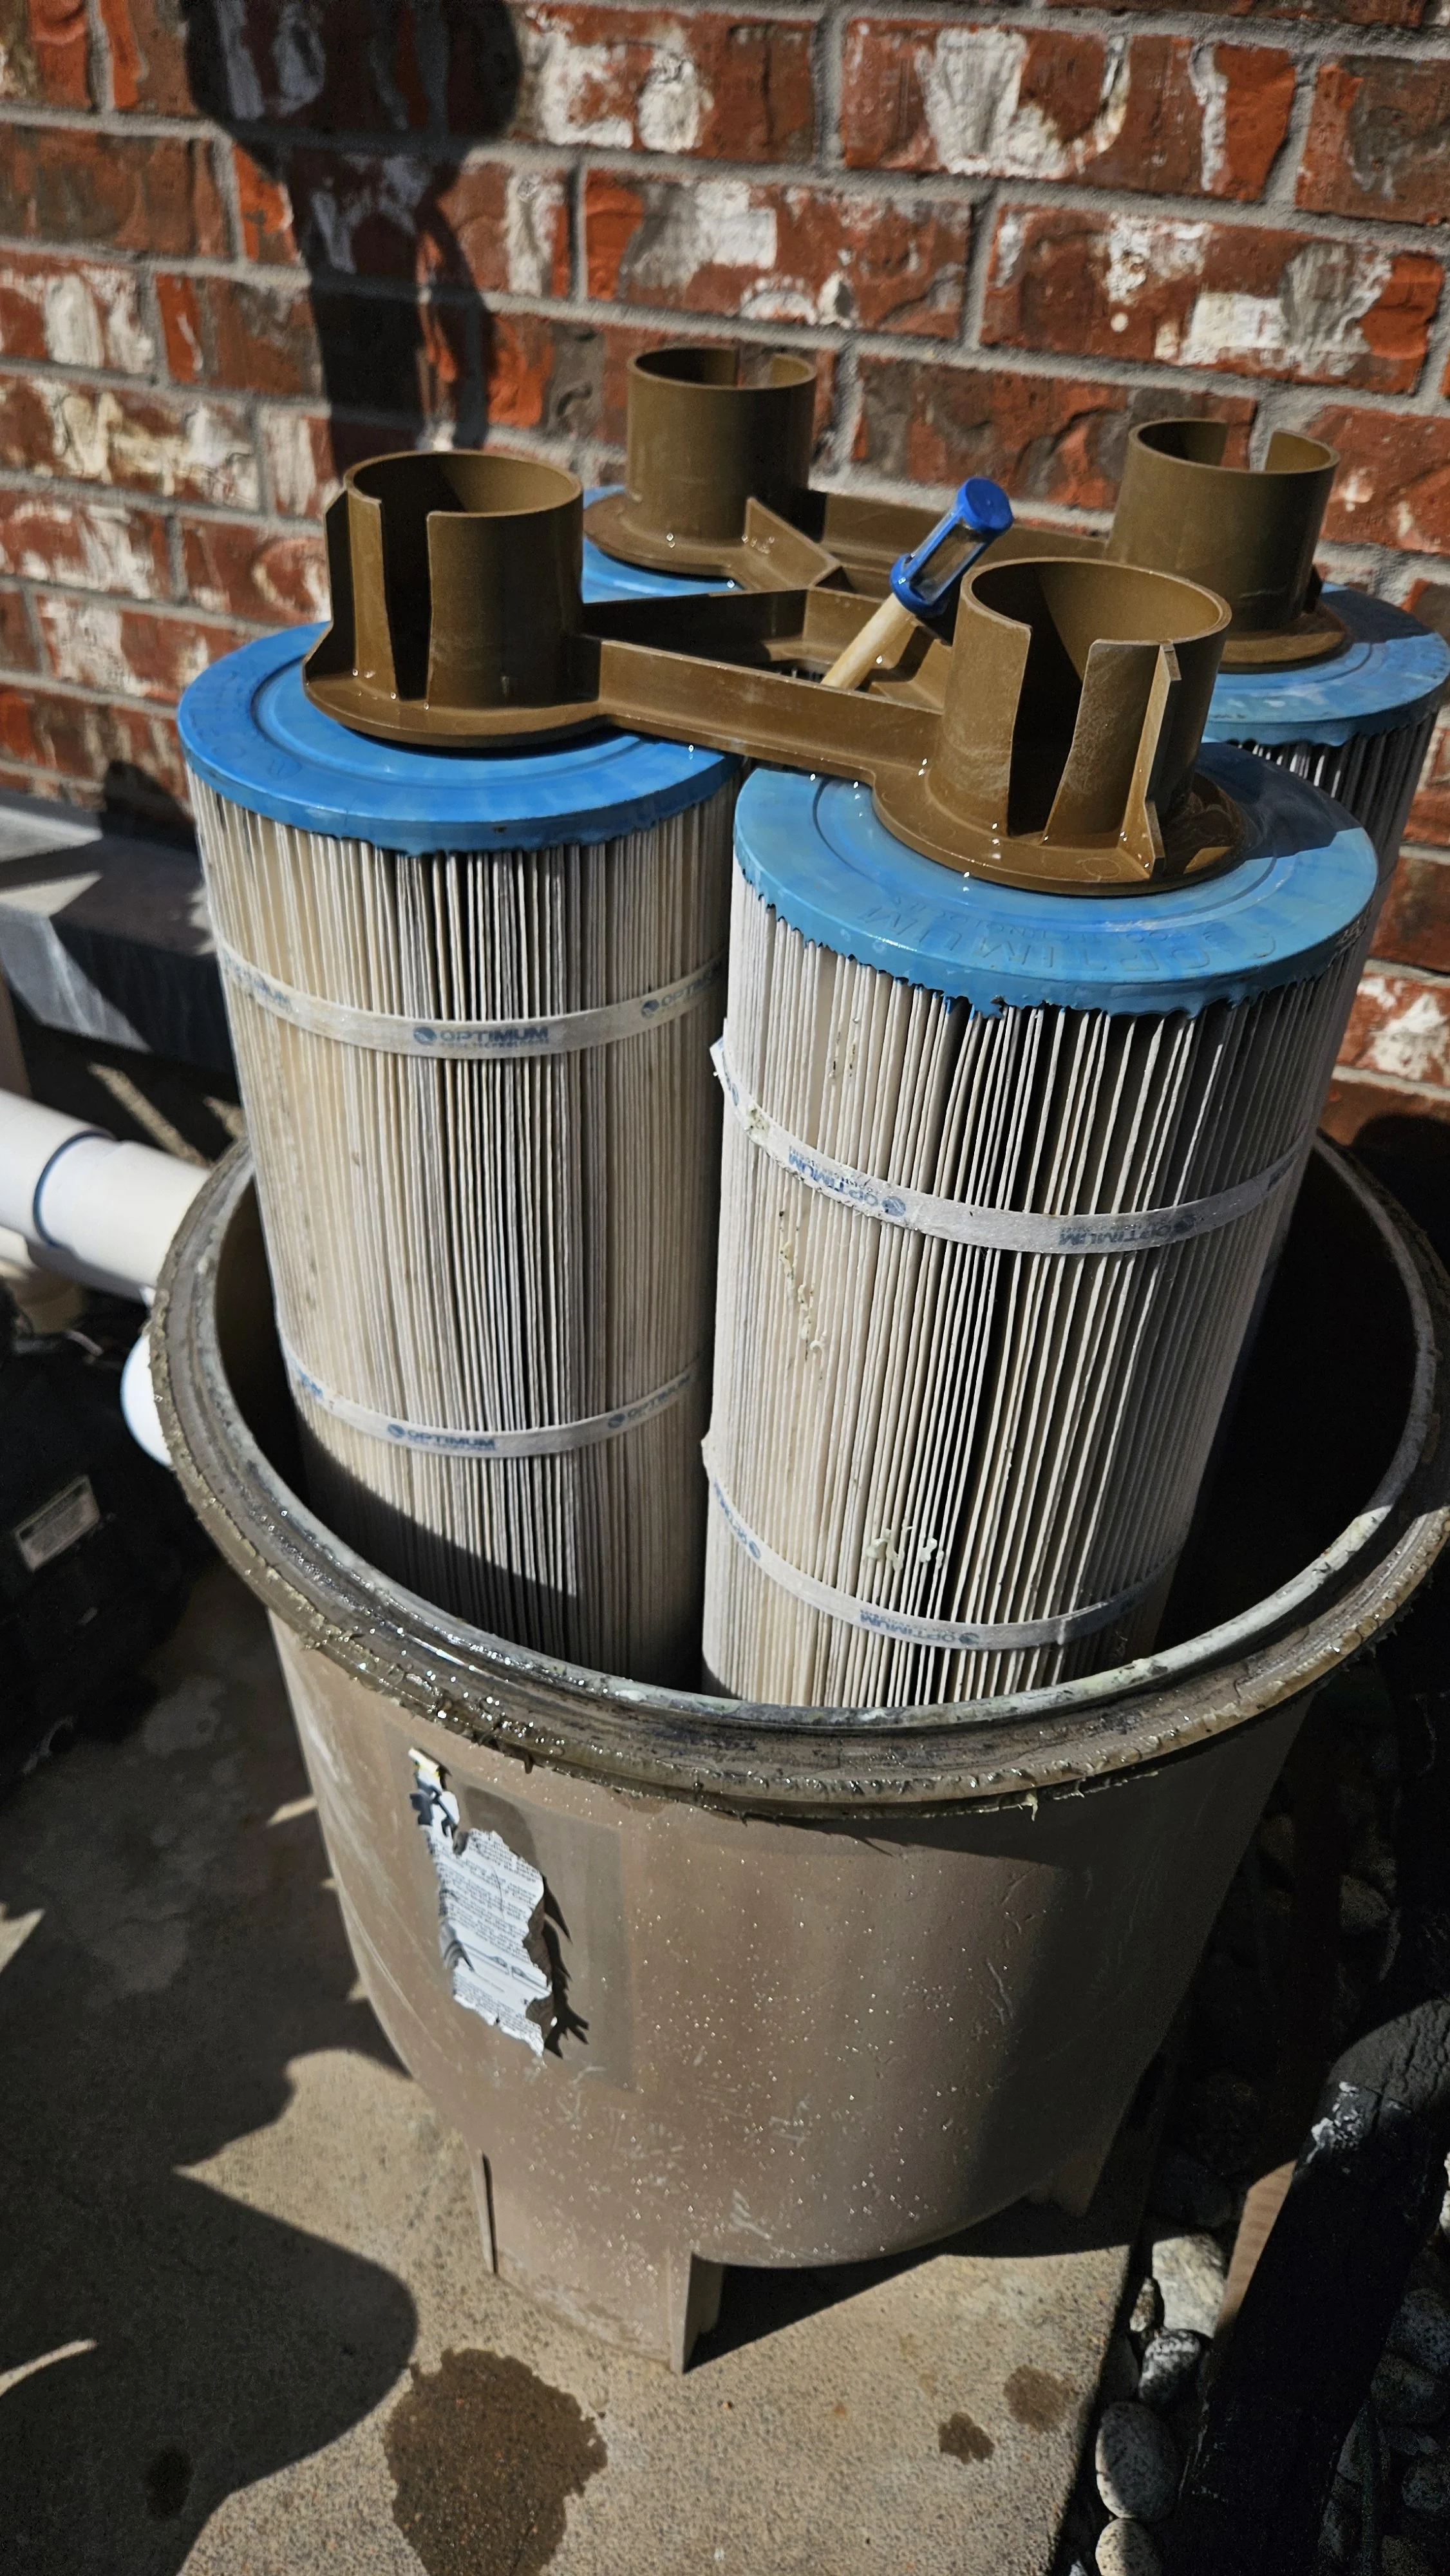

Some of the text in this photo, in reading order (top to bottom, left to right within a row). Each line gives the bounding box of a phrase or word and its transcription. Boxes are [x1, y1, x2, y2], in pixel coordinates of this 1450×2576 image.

[856, 905, 1210, 972] OPTIMUM
[439, 1025, 549, 1042] OPTIMUM
[789, 1153, 878, 1208] OPTIMUM
[1057, 1224, 1171, 1246] OPTIMUM
[408, 1429, 495, 1446] OPTIMUM
[860, 1613, 956, 1643] OPTIMUM
